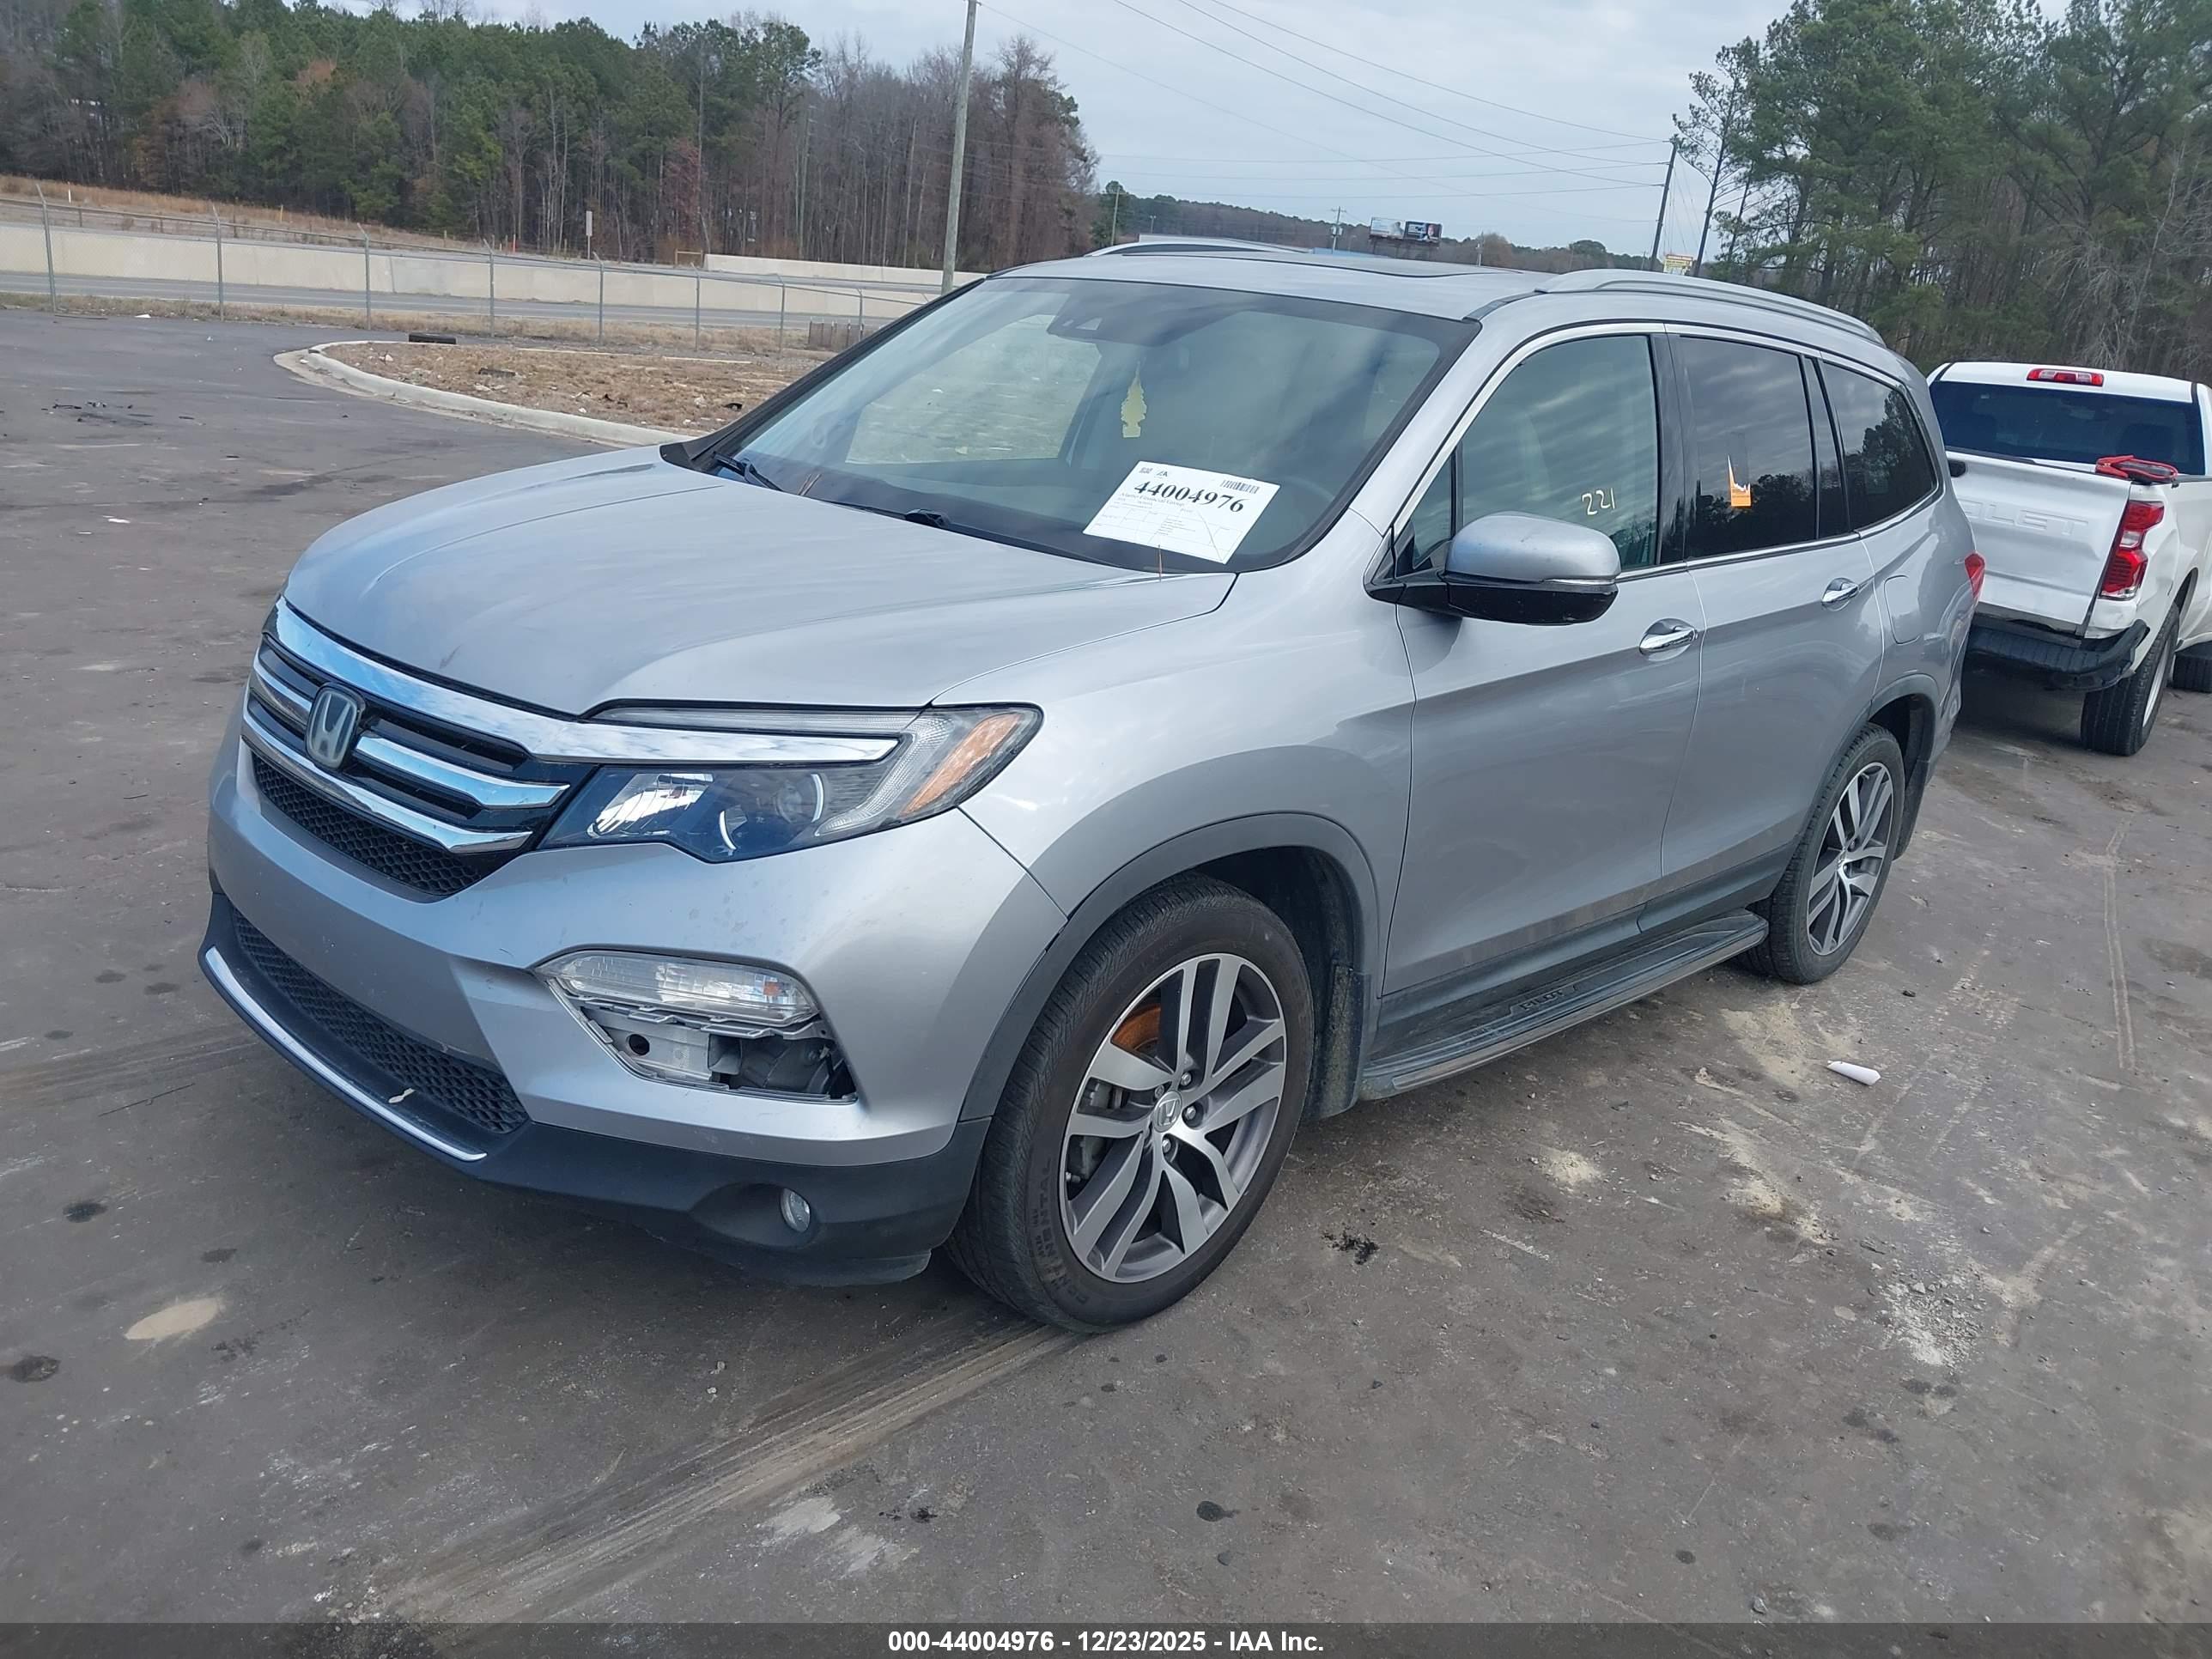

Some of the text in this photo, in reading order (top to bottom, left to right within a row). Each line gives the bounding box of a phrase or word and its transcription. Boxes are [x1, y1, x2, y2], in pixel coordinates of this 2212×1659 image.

[1134, 481, 1250, 513] 44004976
[1581, 487, 1616, 516] 221
[1519, 989, 1565, 1012] PILOT
